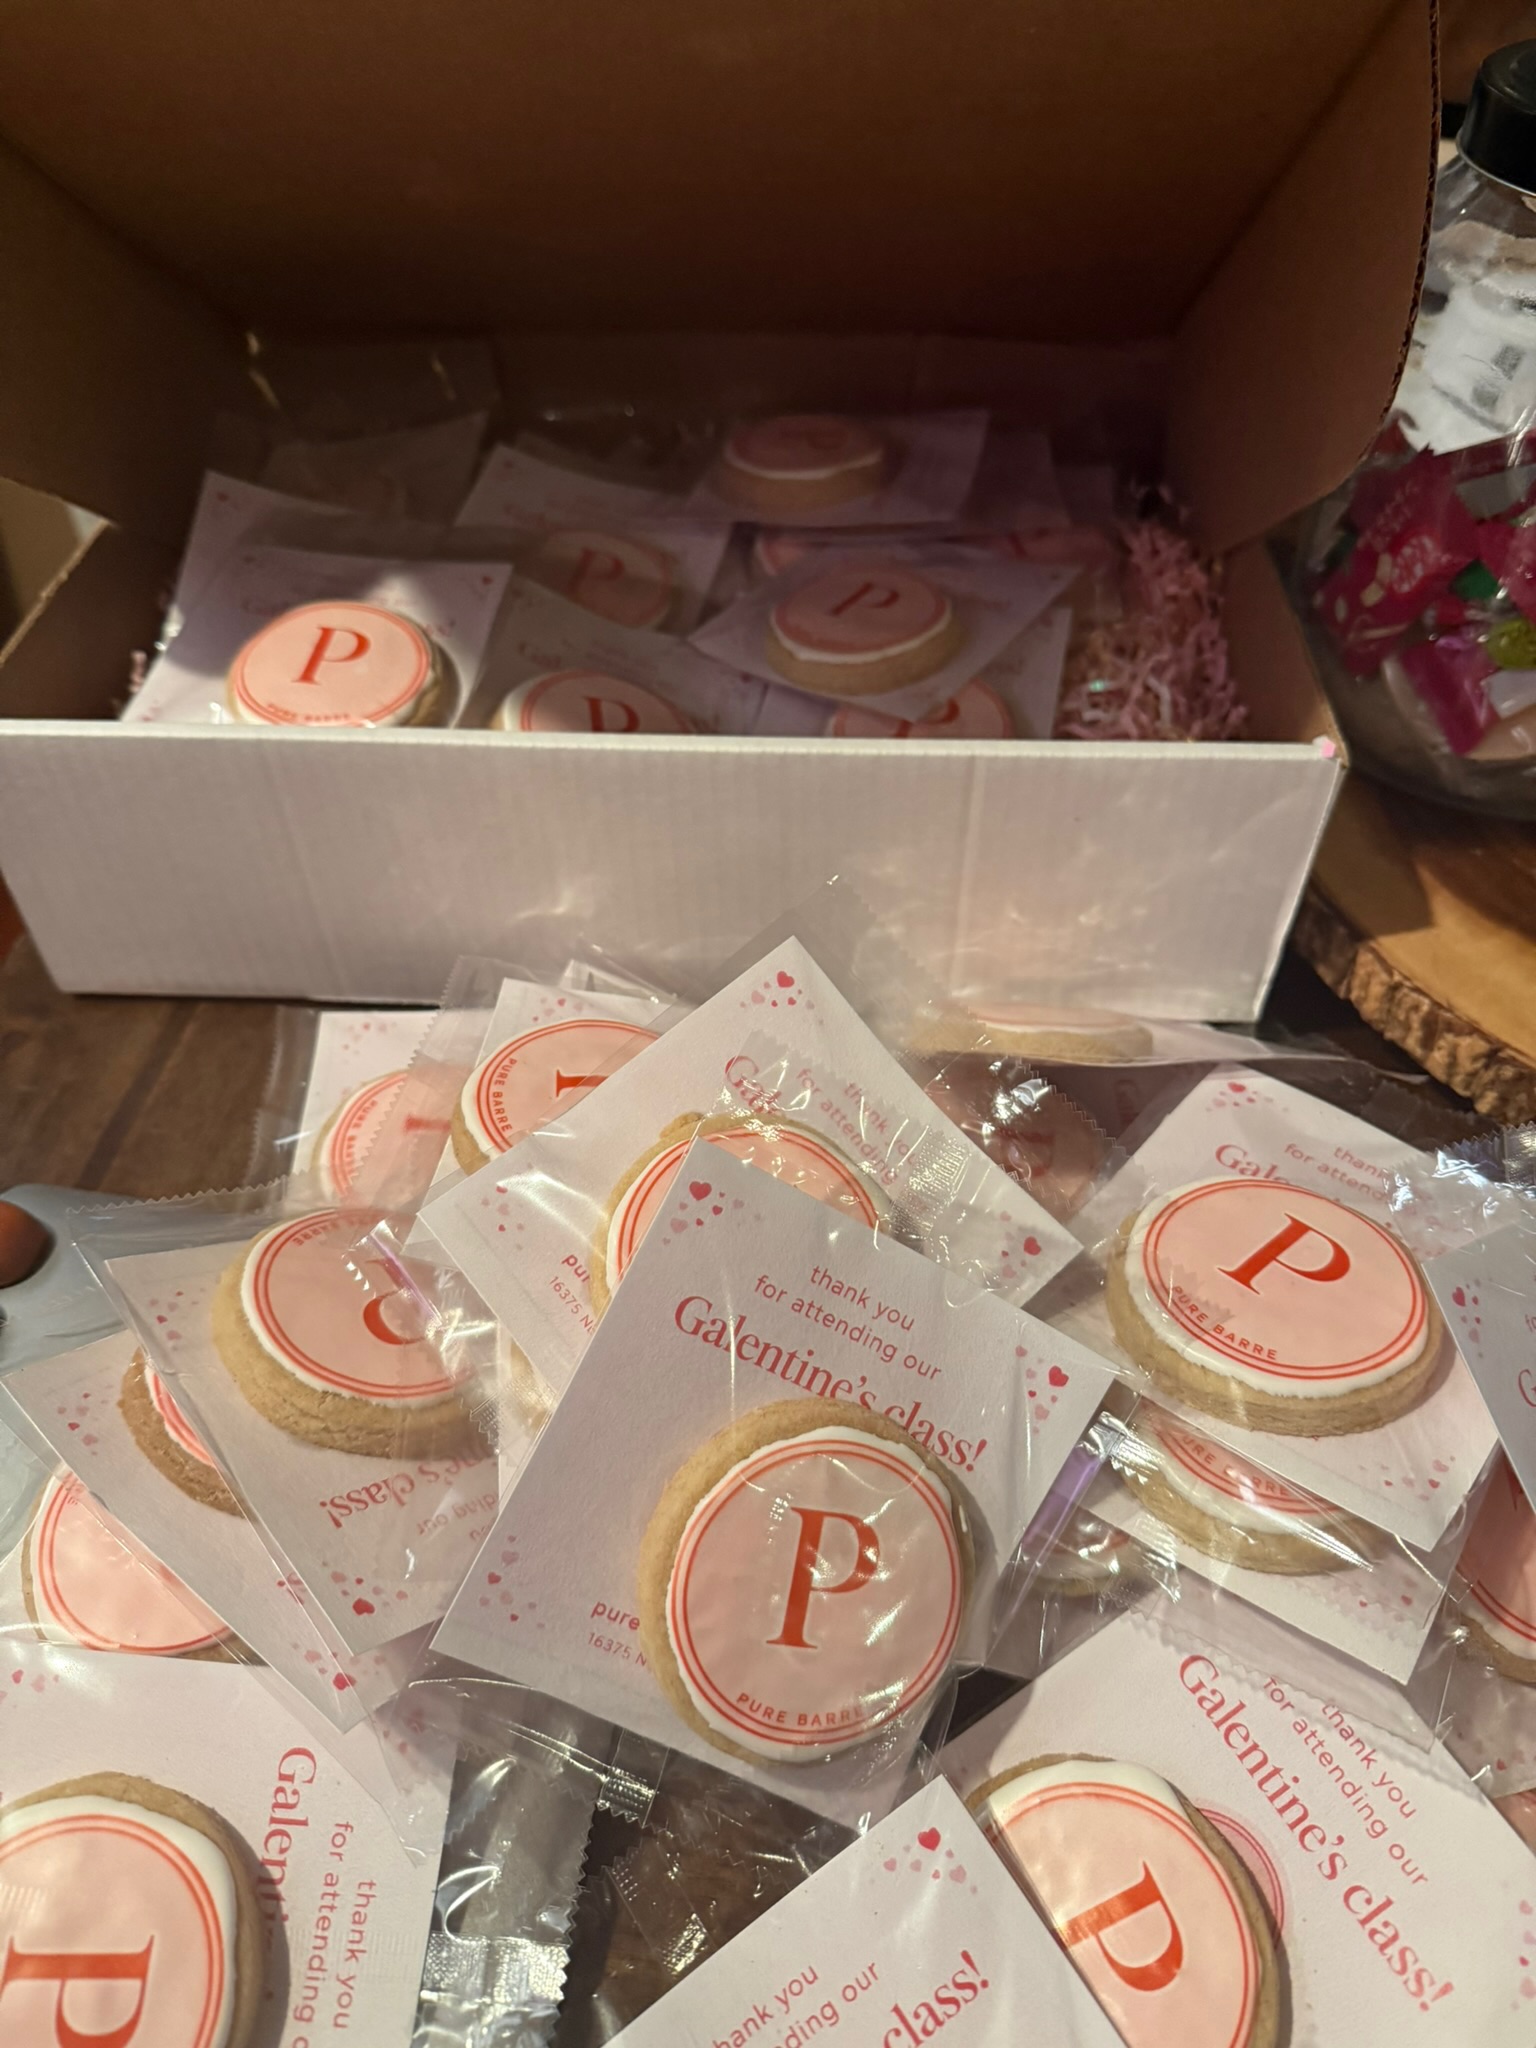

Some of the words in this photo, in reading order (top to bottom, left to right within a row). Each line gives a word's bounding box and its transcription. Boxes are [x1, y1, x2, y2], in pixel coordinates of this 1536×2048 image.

[827, 581, 900, 617] P
[291, 624, 371, 686] P
[494, 1057, 518, 1086] PURE
[492, 1091, 513, 1132] BARRE
[1284, 1142, 1314, 1164] for
[1217, 1212, 1351, 1296] P
[754, 1275, 788, 1302] for
[791, 1297, 898, 1363] attending
[903, 1353, 942, 1381] our
[810, 1265, 871, 1309] thank
[872, 1301, 916, 1331] you
[1173, 1286, 1209, 1323] PURE
[1212, 1324, 1278, 1361] BARRE
[674, 1295, 878, 1411] Galentine's
[883, 1401, 989, 1473] class!
[1181, 1434, 1216, 1465] URE
[1223, 1465, 1290, 1497] BRRE
[319, 1472, 415, 1530] class!
[766, 1506, 882, 1651] P
[587, 1631, 632, 1660] 16375
[590, 1601, 640, 1631] pure
[736, 1692, 788, 1723] PURE
[1321, 1698, 1378, 1770] thank
[1371, 1771, 1417, 1820] you
[1178, 1654, 1349, 1881] Galentine's
[1342, 1884, 1455, 2012] class!
[1292, 1718, 1389, 1839] attending
[1388, 1843, 1429, 1885] our
[257, 1746, 317, 1940] Galenti
[329, 1821, 354, 1862] for
[293, 1872, 341, 2024] attending
[344, 1879, 377, 1963] thank
[1058, 1860, 1184, 1993] P
[0, 1934, 154, 2048] P
[332, 1973, 357, 2030] you
[774, 1965, 819, 2015] you
[841, 1962, 880, 2003] our
[883, 1950, 989, 2048] class!
